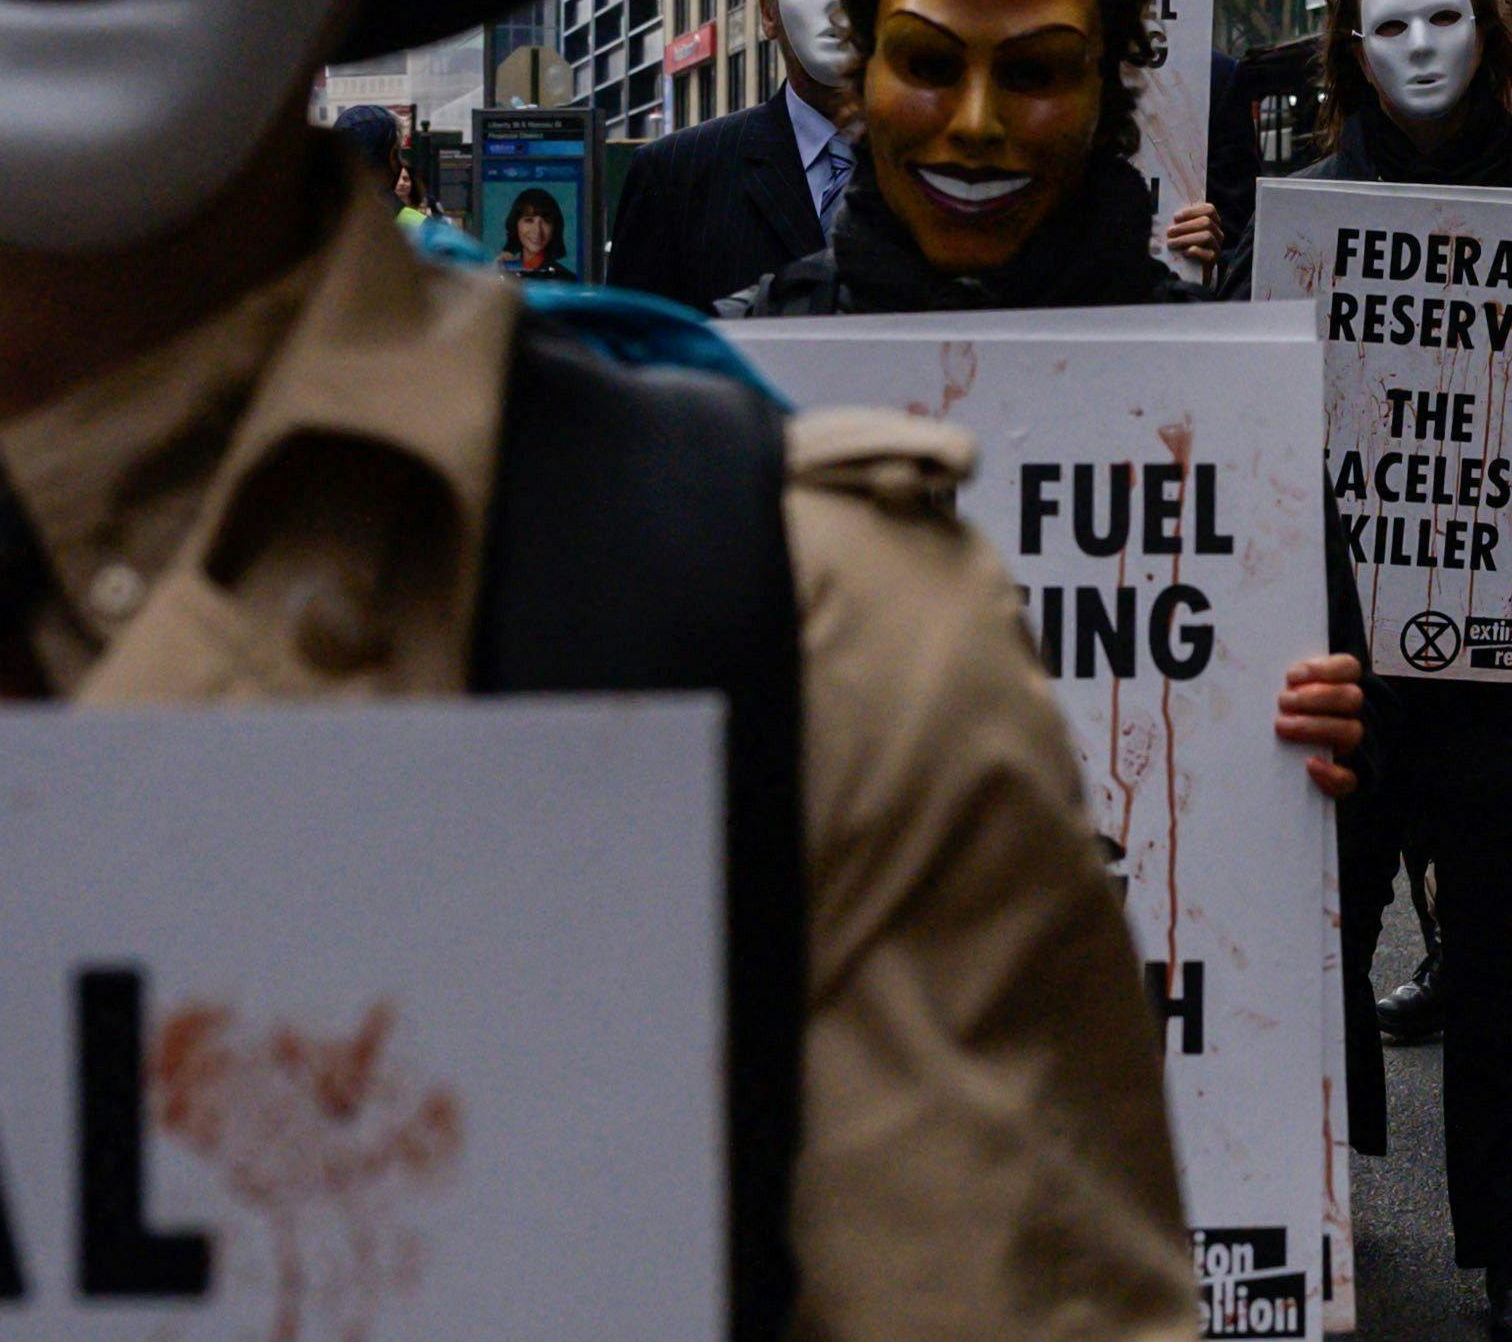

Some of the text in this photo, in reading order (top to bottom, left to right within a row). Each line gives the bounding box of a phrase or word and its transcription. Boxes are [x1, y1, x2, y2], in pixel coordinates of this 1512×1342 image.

[1387, 388, 1475, 443] THE
[1020, 460, 1234, 557] FUEL
[1341, 514, 1498, 571] KILLER
